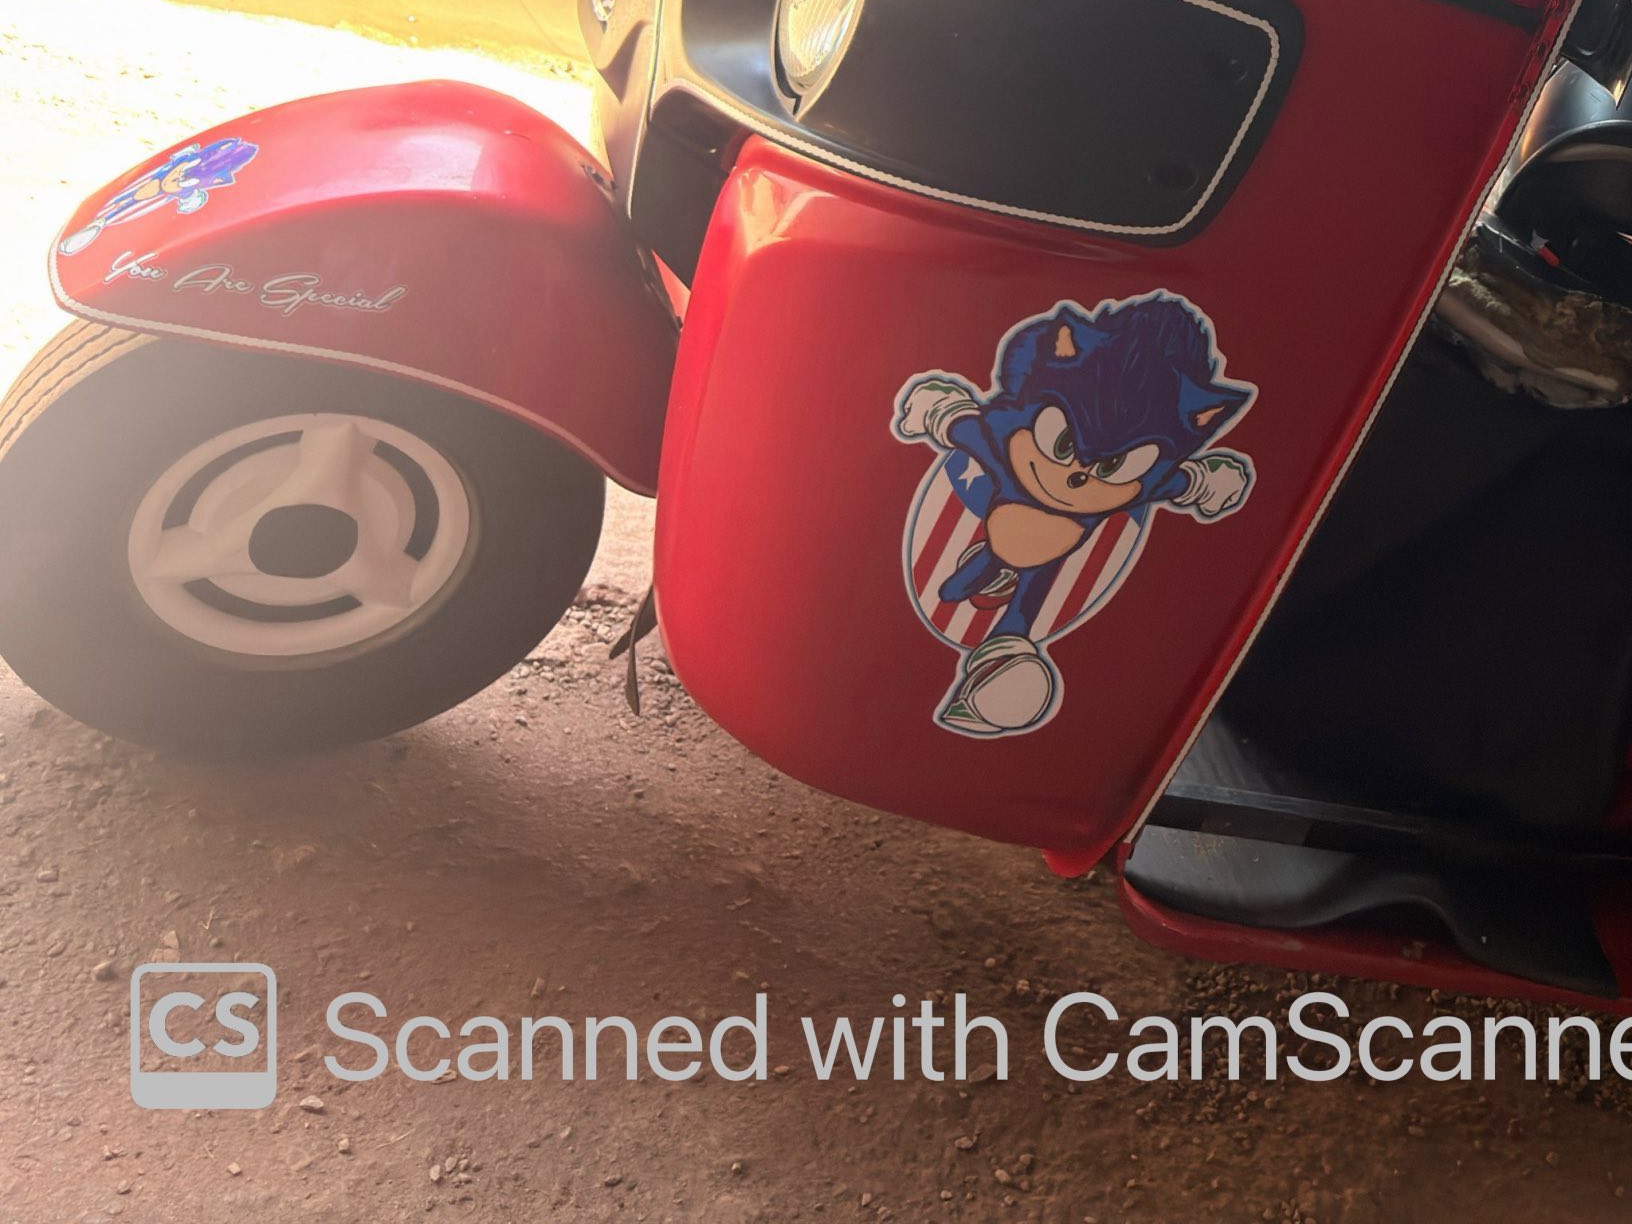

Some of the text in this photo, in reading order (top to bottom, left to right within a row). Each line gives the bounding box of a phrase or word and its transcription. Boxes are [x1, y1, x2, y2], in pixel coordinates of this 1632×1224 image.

[104, 250, 408, 317] You Are Special
